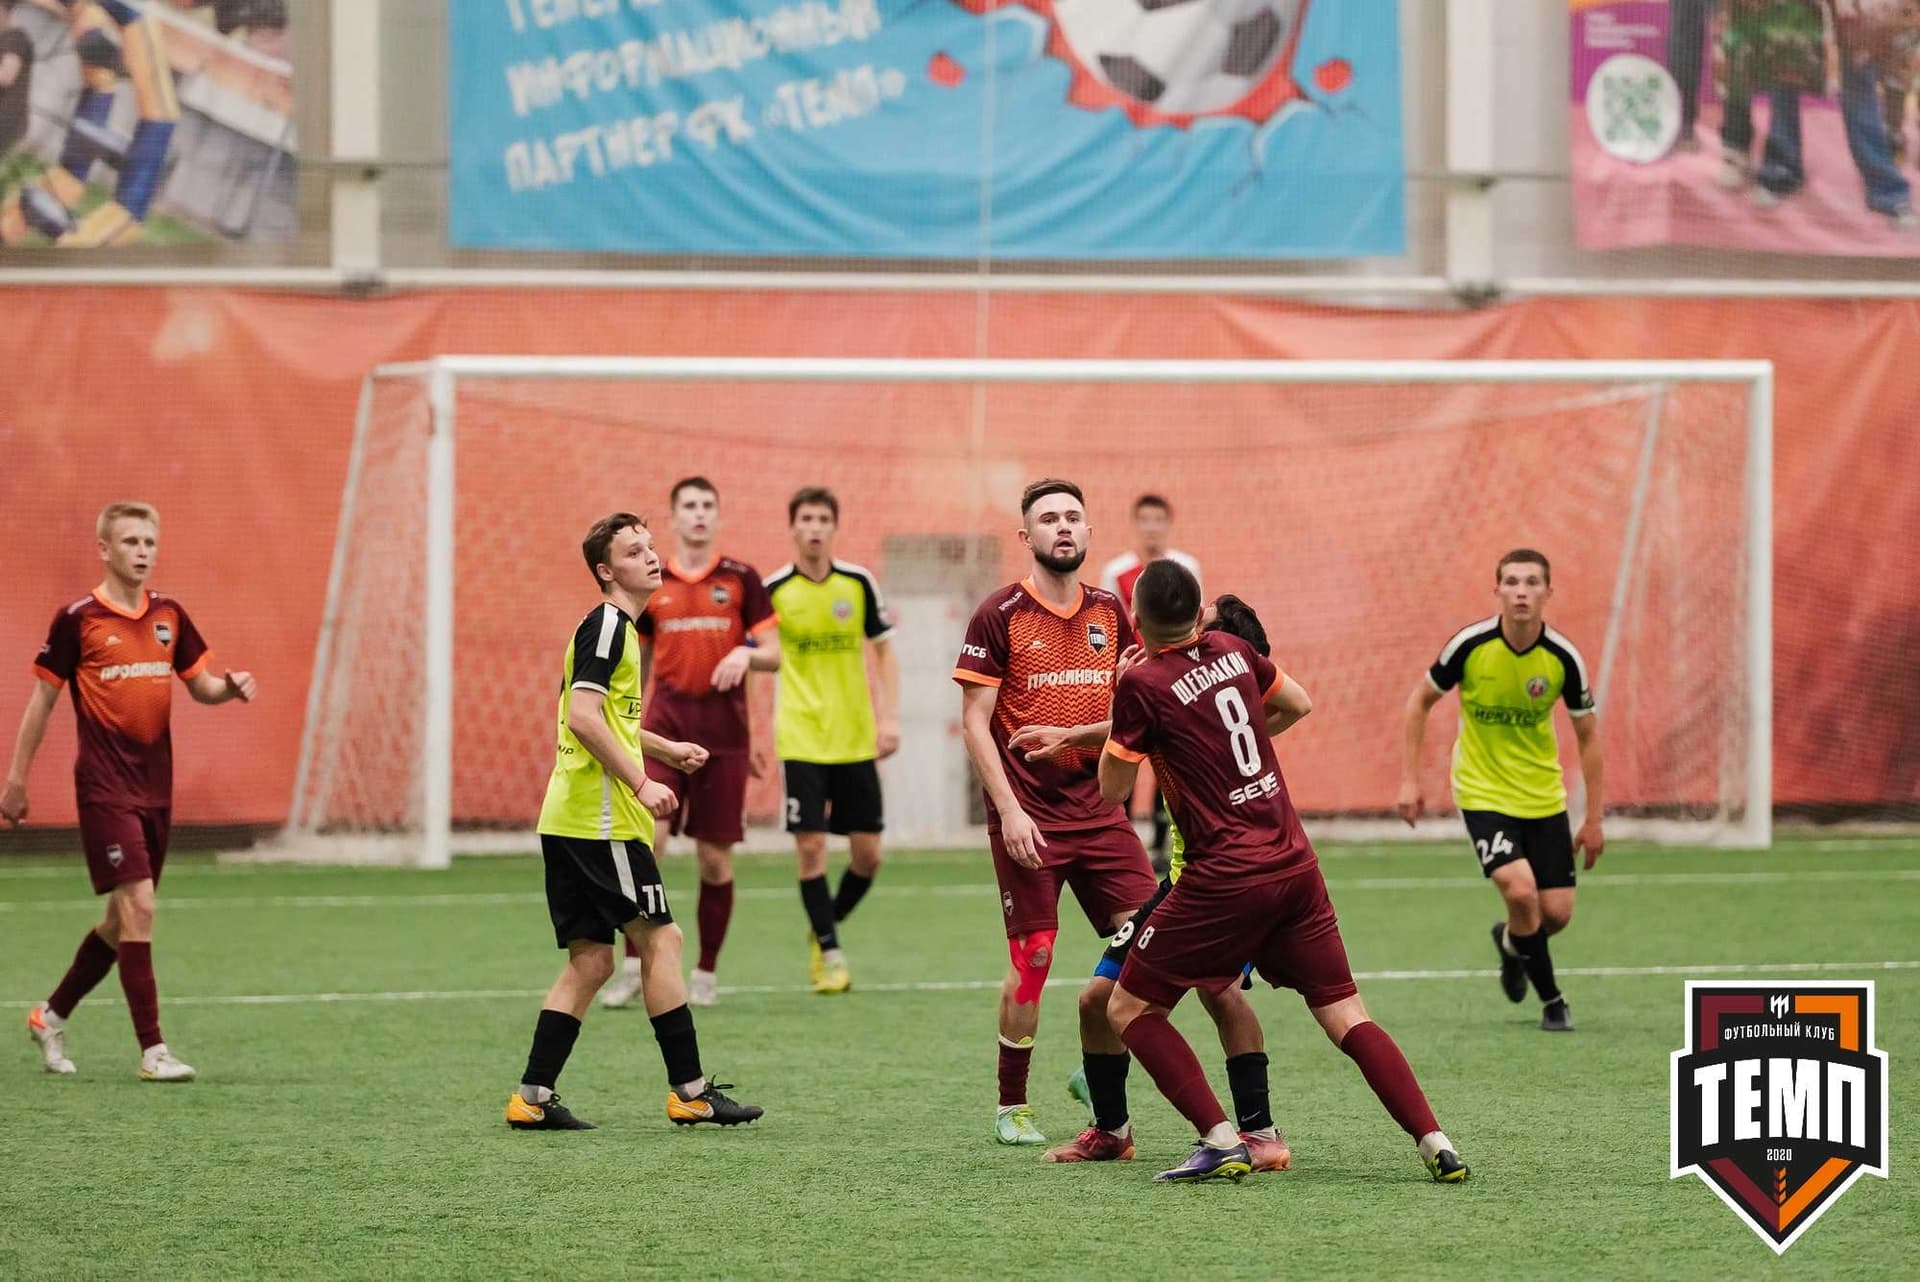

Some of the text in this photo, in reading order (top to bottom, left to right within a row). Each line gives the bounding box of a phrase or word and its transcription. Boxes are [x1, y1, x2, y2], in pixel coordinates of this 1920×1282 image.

[505, 110, 679, 192] ПАРТНЕР
[1215, 686, 1262, 777] 8
[1476, 830, 1514, 866] 24
[1111, 920, 1135, 948] 9
[1137, 926, 1155, 950] 8
